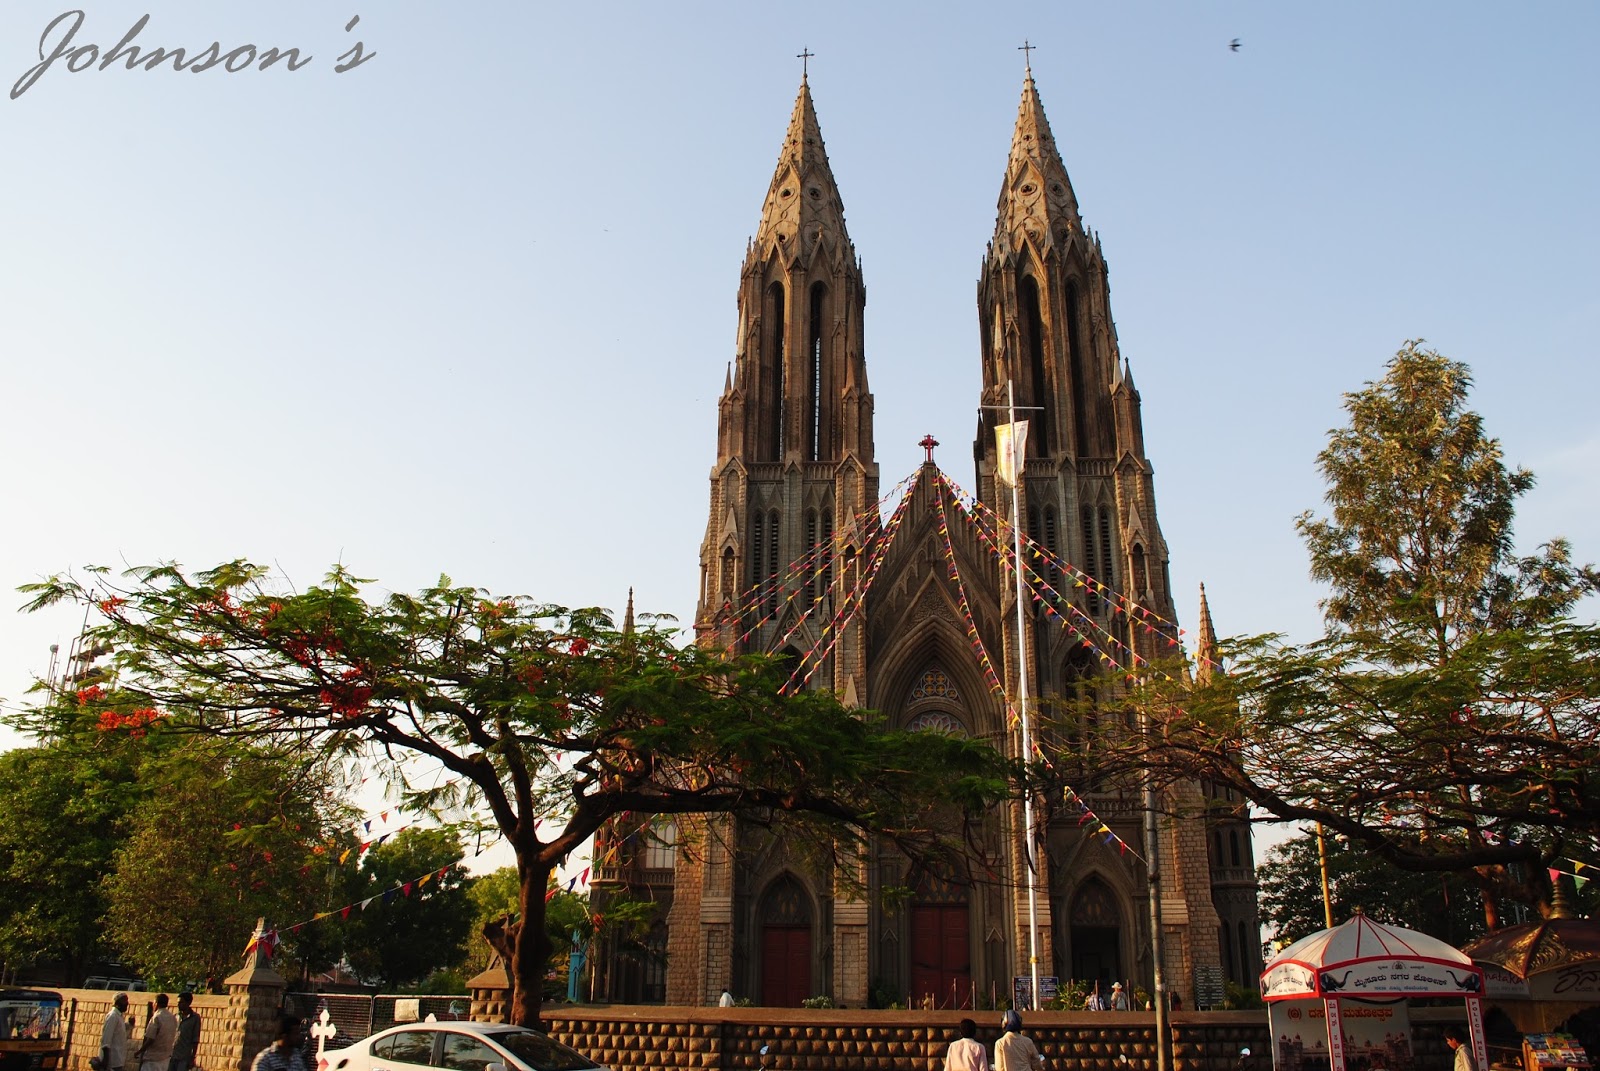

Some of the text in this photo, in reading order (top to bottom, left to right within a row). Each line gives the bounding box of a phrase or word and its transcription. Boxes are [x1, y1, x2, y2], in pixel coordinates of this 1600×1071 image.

[1484, 971, 1524, 985] nataka
[1471, 1001, 1480, 1034] POLICE
[1477, 1040, 1485, 1062] HELP
